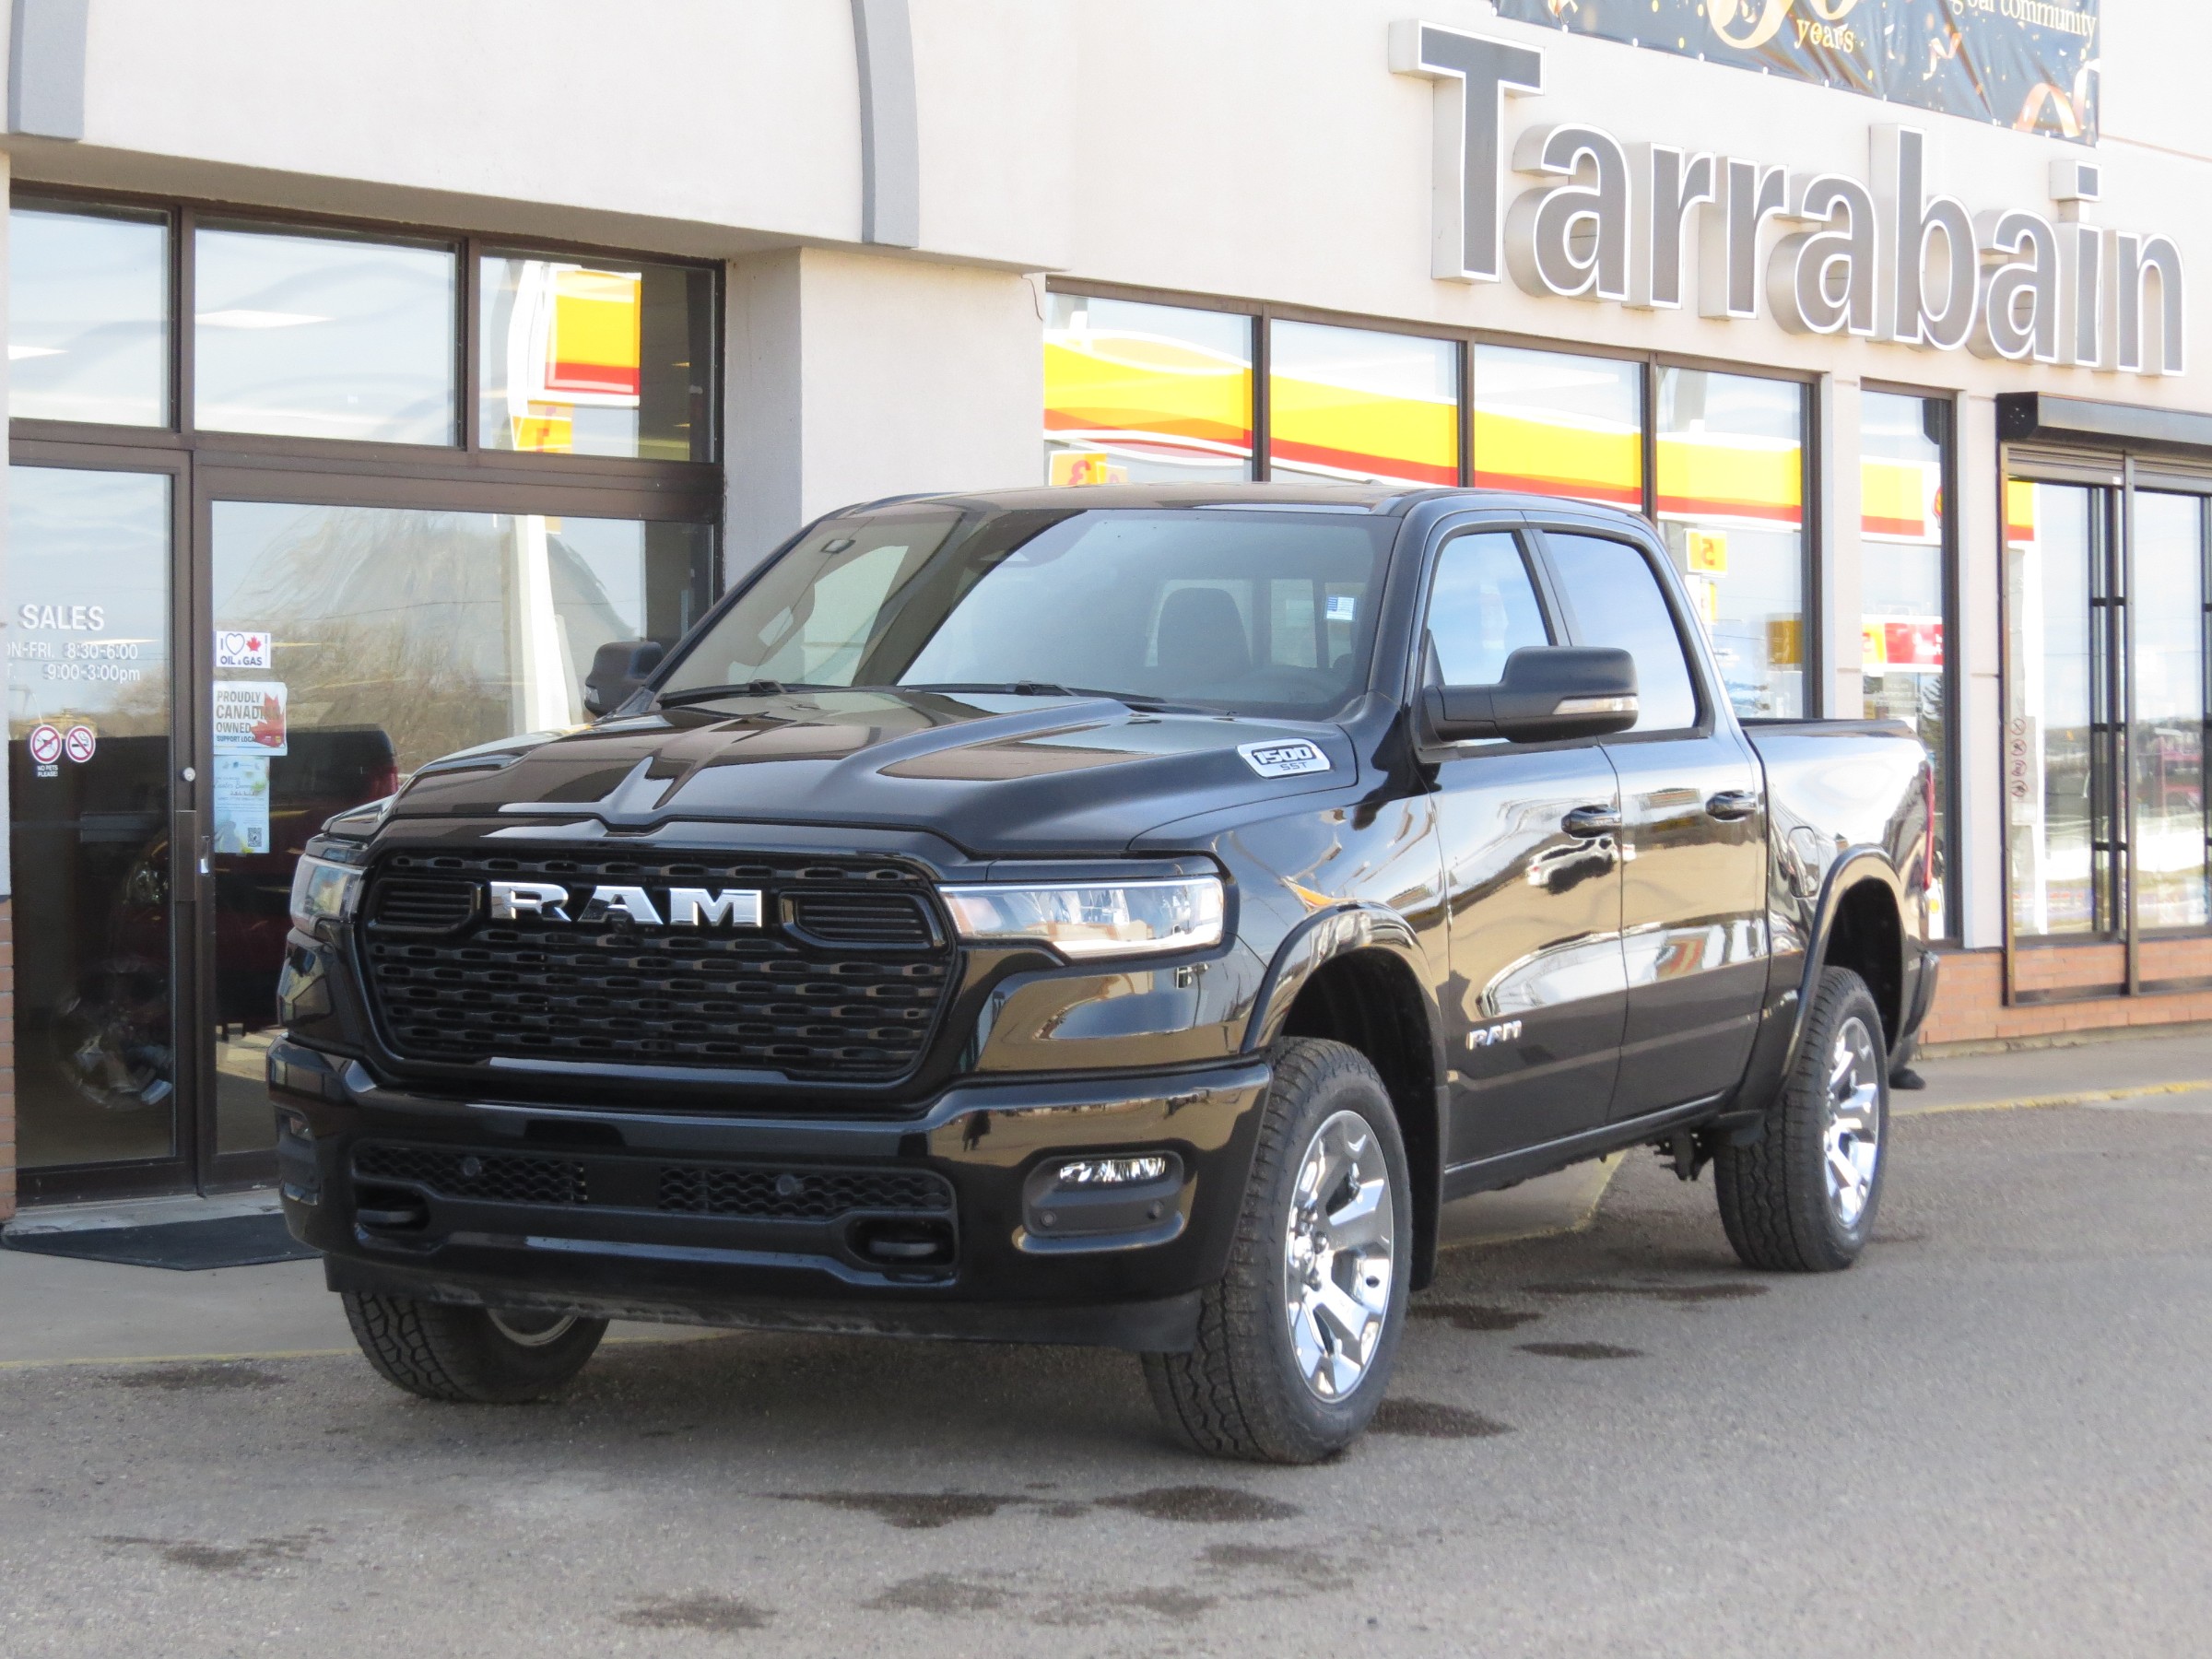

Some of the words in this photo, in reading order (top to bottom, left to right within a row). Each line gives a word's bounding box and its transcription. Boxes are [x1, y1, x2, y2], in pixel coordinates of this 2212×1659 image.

[1794, 18, 1854, 53] years
[1390, 18, 2185, 378] Tarrabain
[21, 604, 105, 631] SALES
[7, 641, 54, 659] N-FRI.
[66, 642, 138, 660] 8:30-6:00
[220, 655, 236, 665] OIL
[242, 656, 263, 665] GAS
[47, 663, 140, 684] 9:00-3:00pm
[217, 690, 261, 703] PROUDLY
[216, 722, 252, 734] OWNED
[217, 735, 241, 743] SUPPORT
[1253, 747, 1313, 765] 1500
[1279, 760, 1308, 771] SST
[489, 880, 762, 928] RAM
[1466, 1019, 1523, 1051] RAM
